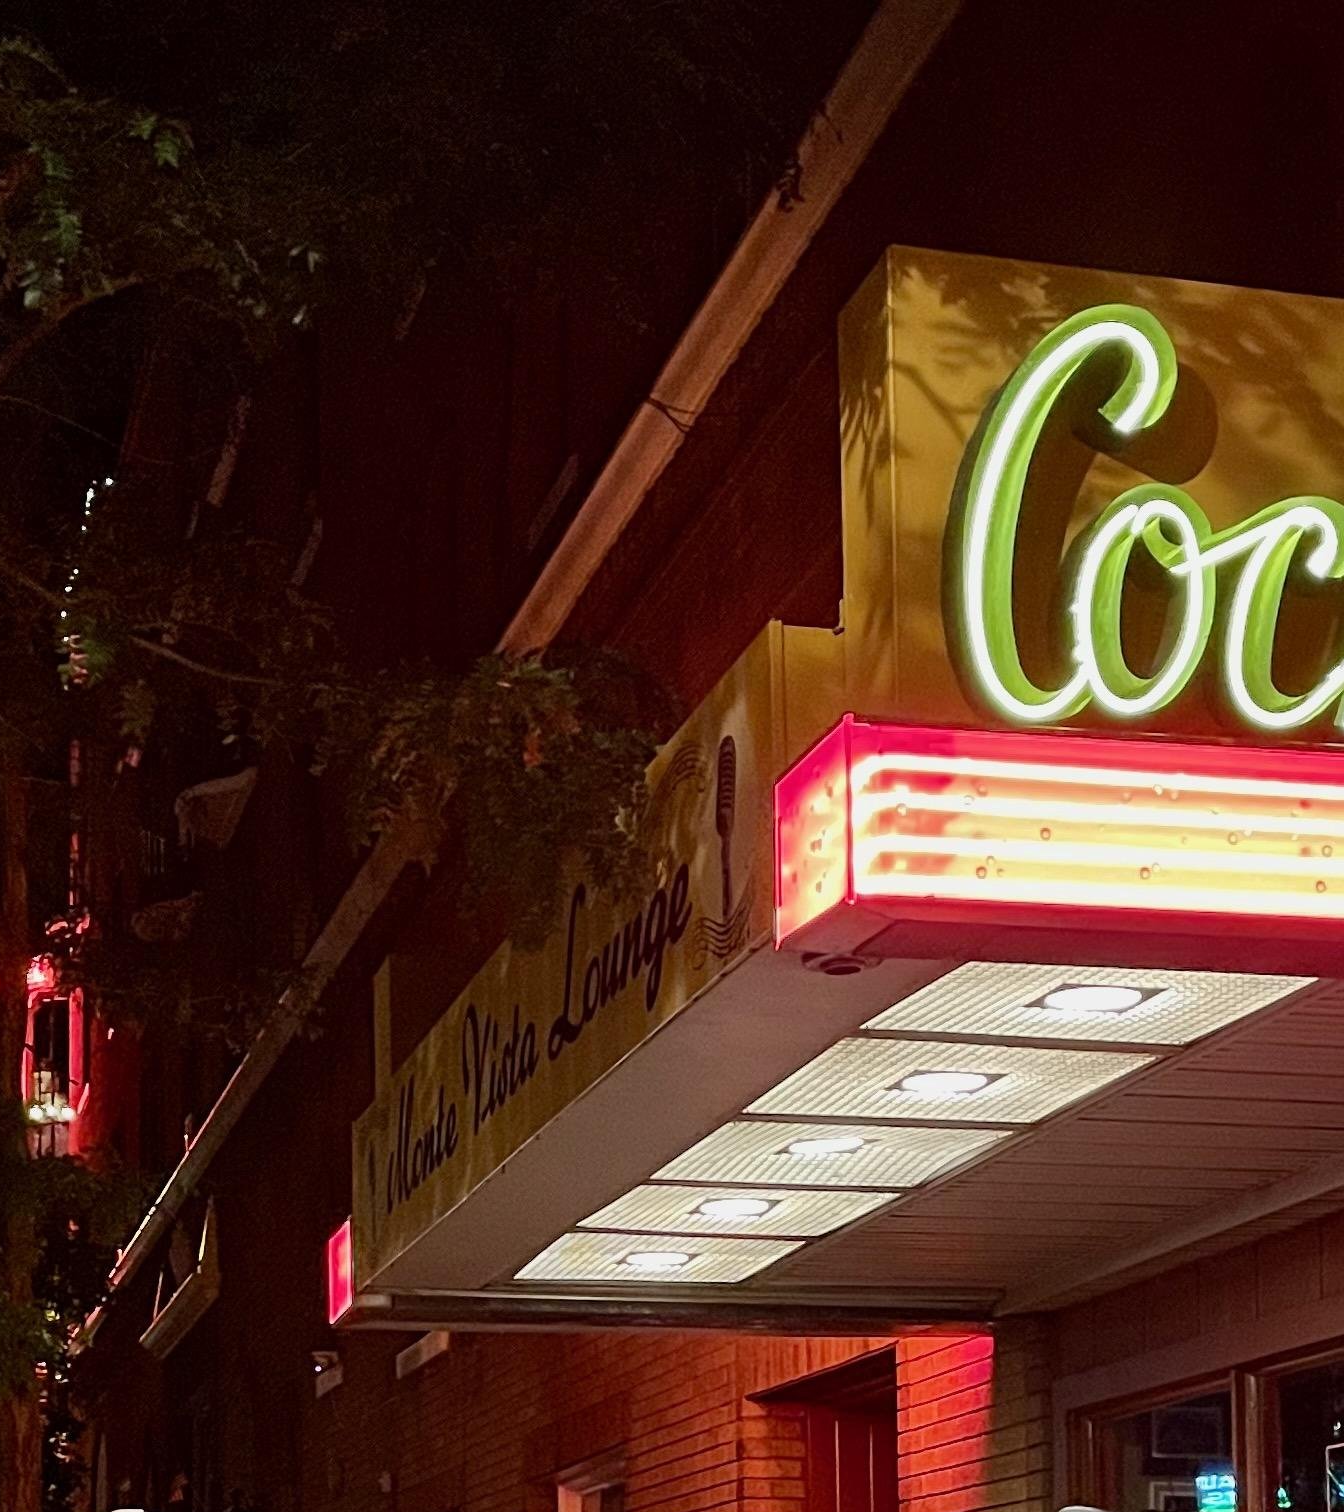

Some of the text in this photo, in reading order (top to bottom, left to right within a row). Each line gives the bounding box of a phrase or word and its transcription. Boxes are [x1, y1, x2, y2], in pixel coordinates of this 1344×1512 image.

[386, 863, 693, 1216] Monte Vista Lounge
